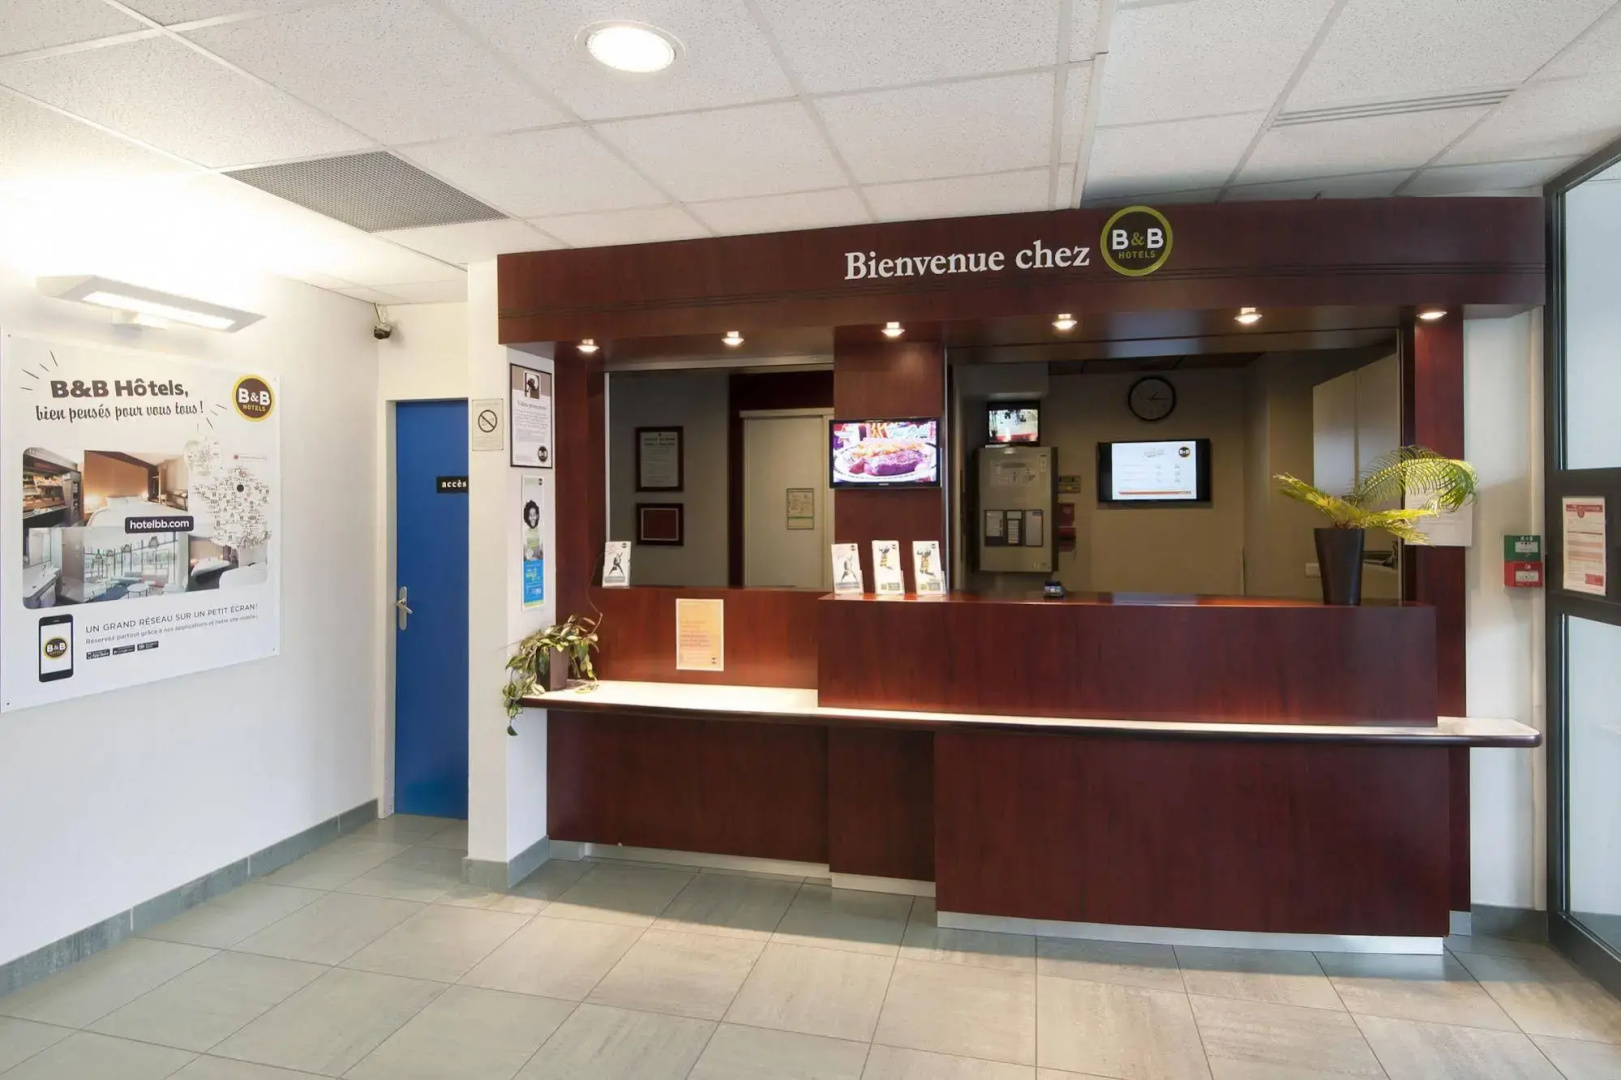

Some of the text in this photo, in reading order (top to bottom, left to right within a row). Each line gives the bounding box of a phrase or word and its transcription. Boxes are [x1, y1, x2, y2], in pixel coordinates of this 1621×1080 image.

[1112, 227, 1164, 250] B&B
[844, 239, 1090, 281] Bienvenue chez
[1118, 250, 1156, 259] HOTELS
[50, 378, 188, 398] B&B Hôtels,
[238, 387, 271, 406] B&B
[35, 405, 66, 421] bien
[68, 403, 111, 423] pensés
[115, 406, 143, 421] pour
[146, 405, 172, 416] vous
[175, 401, 198, 415] tous
[242, 404, 266, 412] HOTELS
[441, 479, 467, 488] accès
[130, 519, 190, 530] hotelbb.com
[85, 625, 100, 634] UN
[102, 620, 137, 631] GRAND
[139, 615, 173, 626] RÉSEAU
[175, 612, 192, 621] SUR
[193, 610, 205, 618] UN
[207, 607, 228, 616] PETIT
